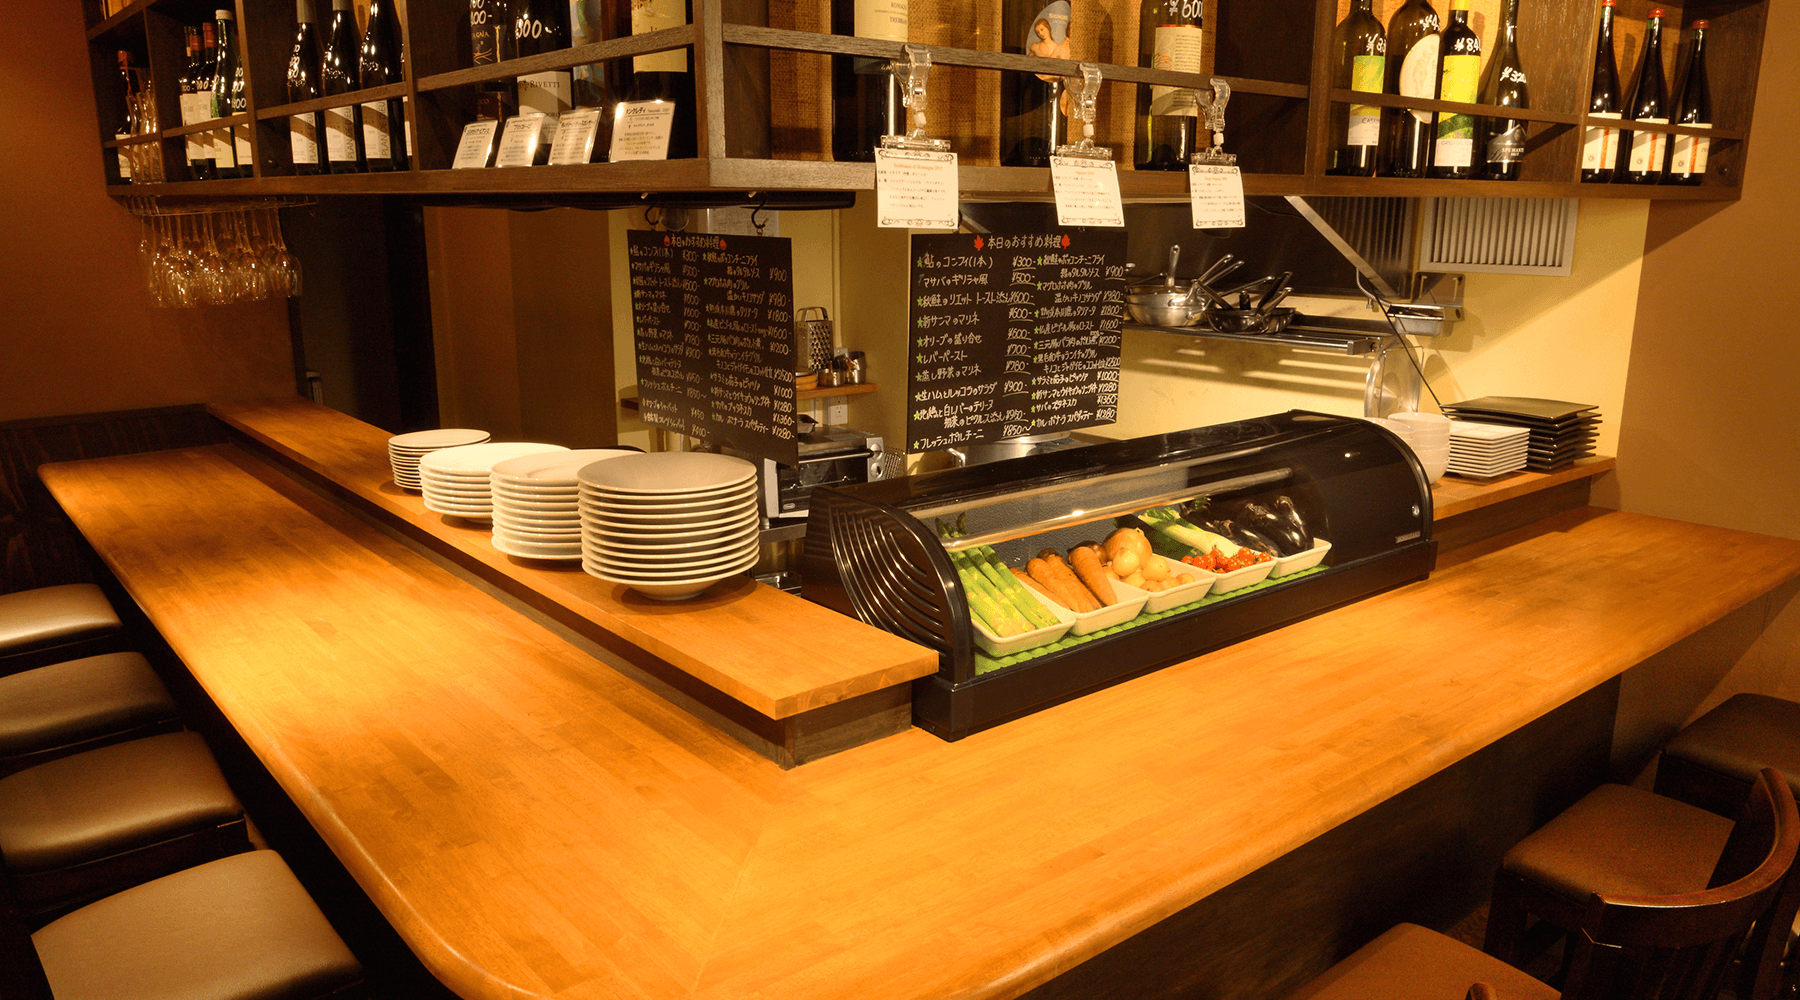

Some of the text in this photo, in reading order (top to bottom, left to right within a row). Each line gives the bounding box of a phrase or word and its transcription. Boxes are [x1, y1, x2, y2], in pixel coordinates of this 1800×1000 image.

[530, 80, 560, 88] RIVETTI
[308, 142, 317, 161] PLAN
[346, 138, 355, 159] PLAN
[381, 134, 389, 156] PLAN
[987, 234, 1061, 250] 本日のおすすめ料理
